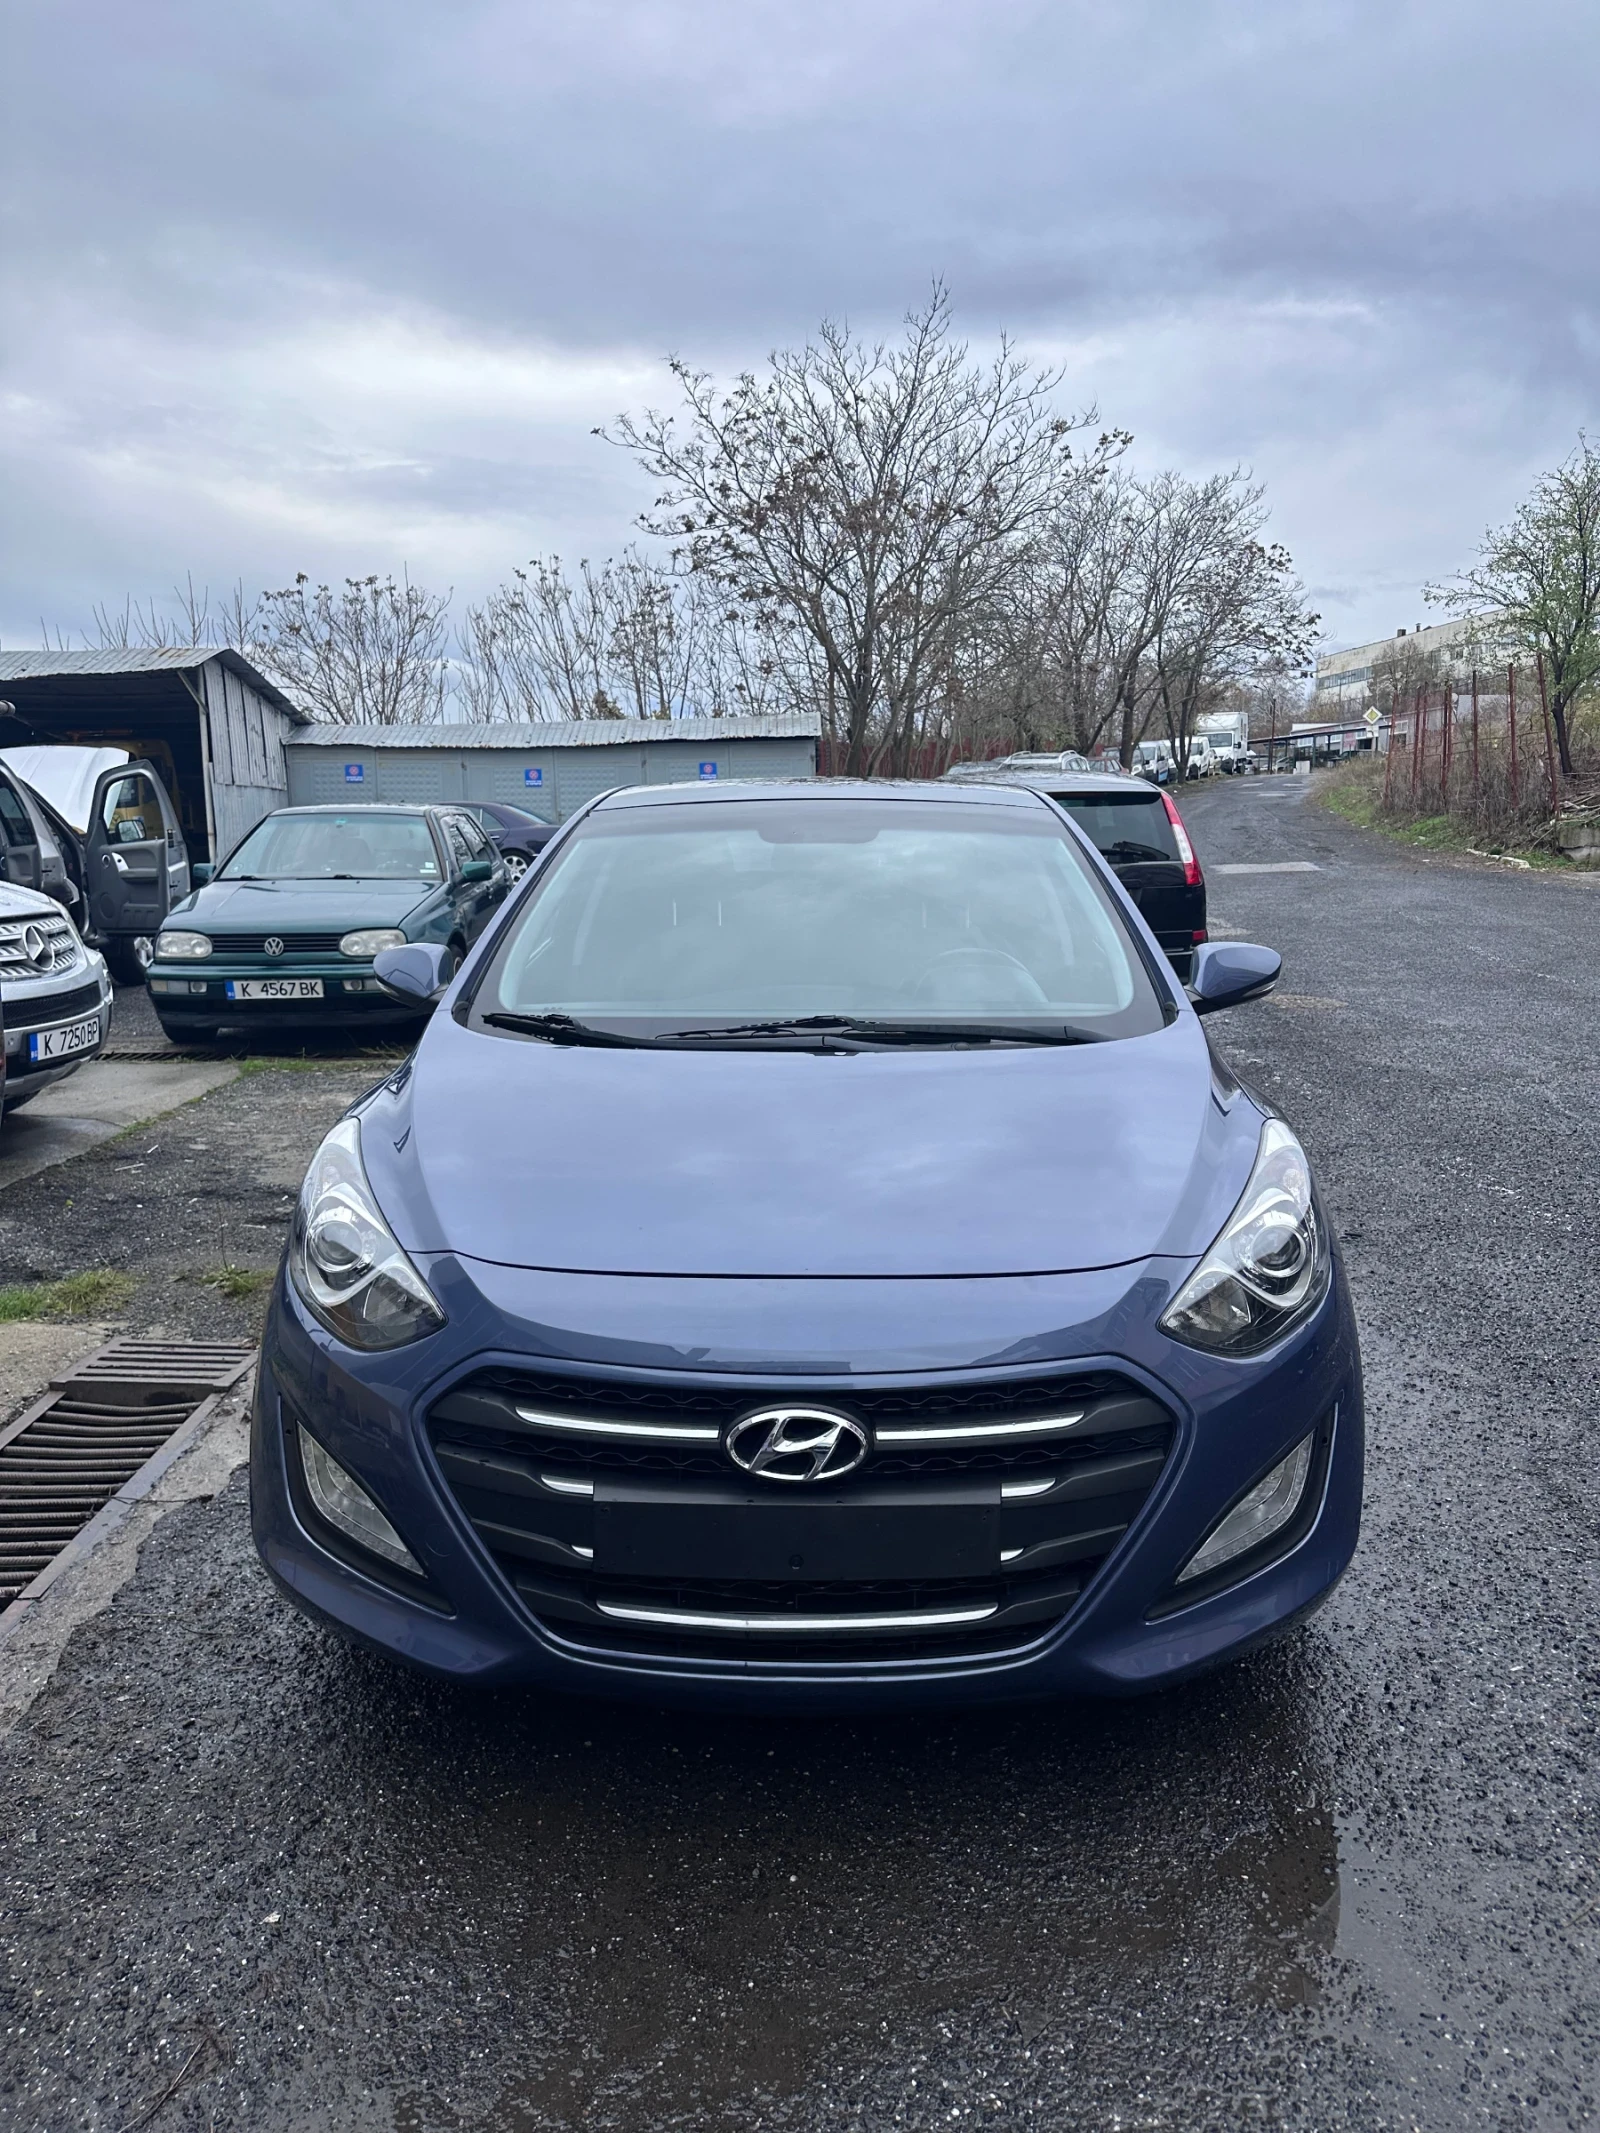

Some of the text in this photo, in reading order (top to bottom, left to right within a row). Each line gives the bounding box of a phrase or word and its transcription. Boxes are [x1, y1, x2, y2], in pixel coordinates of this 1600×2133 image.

[241, 983, 252, 997] K
[260, 982, 296, 996] 4567
[300, 981, 320, 996] BK
[44, 1020, 98, 1056] K 7250 BP
